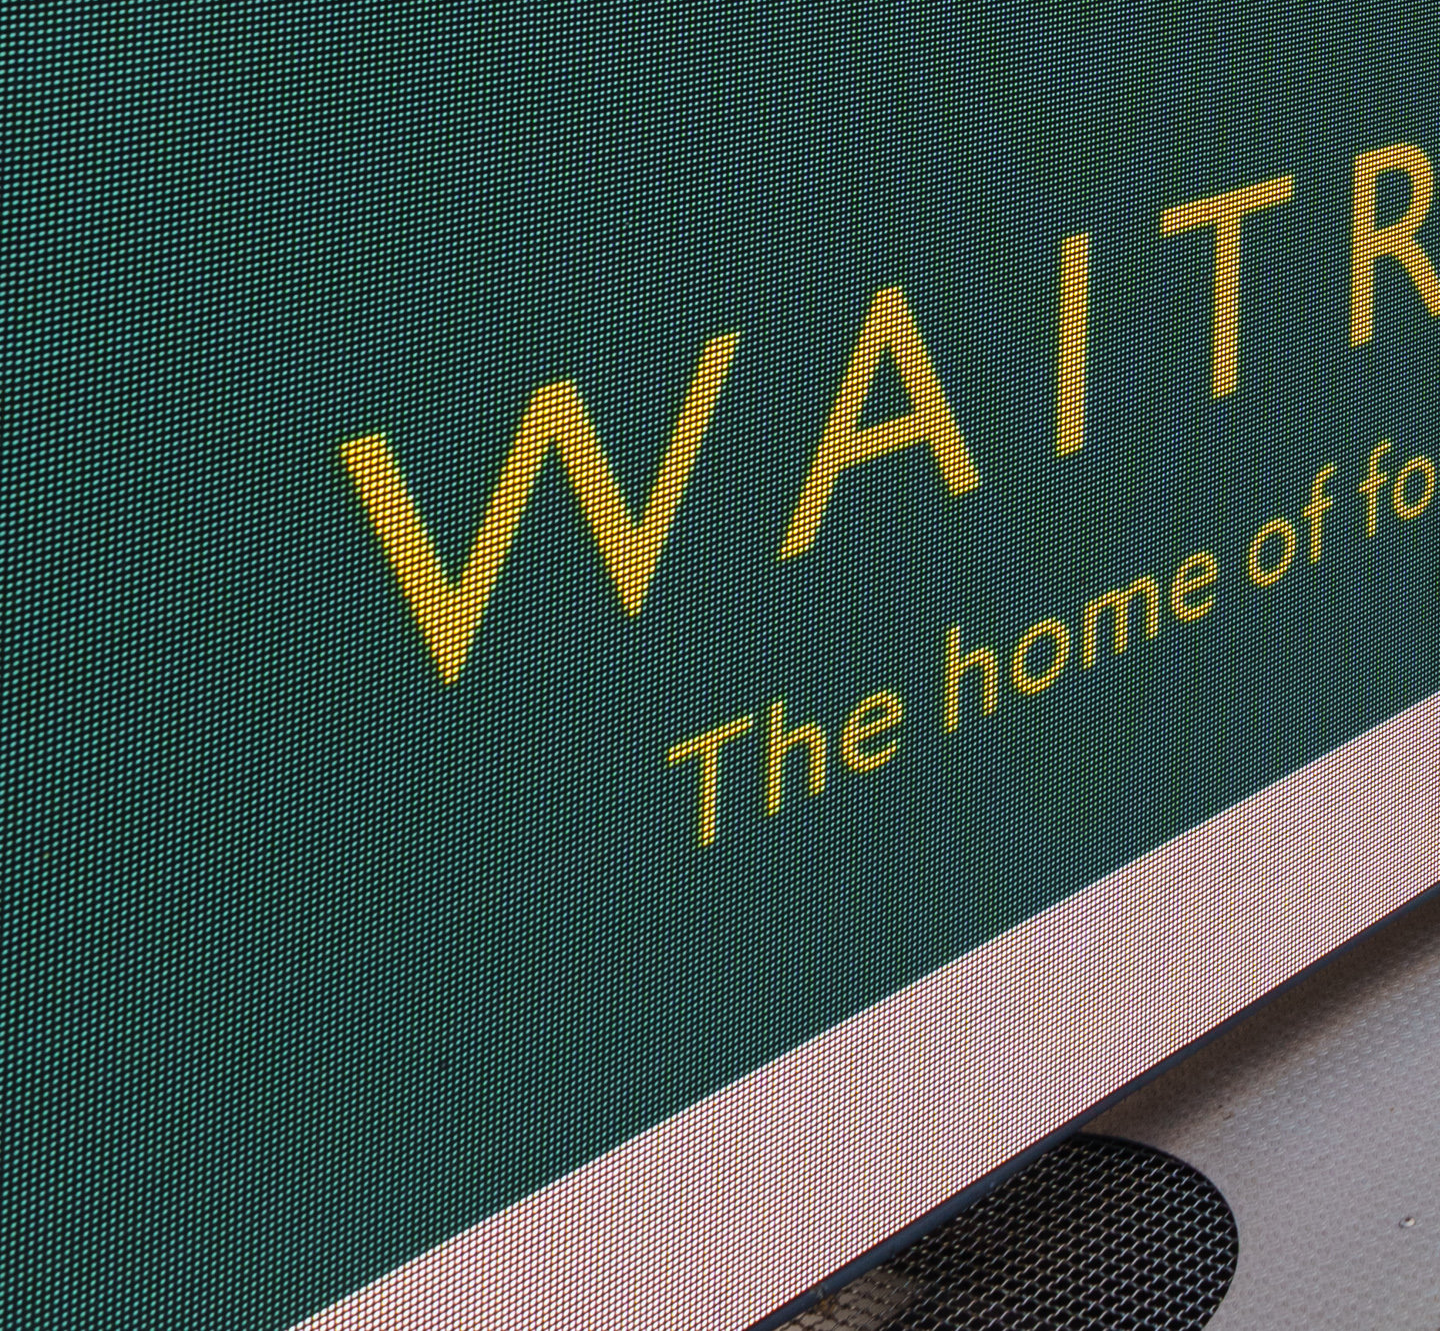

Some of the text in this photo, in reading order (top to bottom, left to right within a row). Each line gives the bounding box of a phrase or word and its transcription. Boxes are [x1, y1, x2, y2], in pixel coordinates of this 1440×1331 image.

[669, 682, 903, 846] The
[942, 547, 1219, 733] home
[1247, 489, 1341, 587] of
